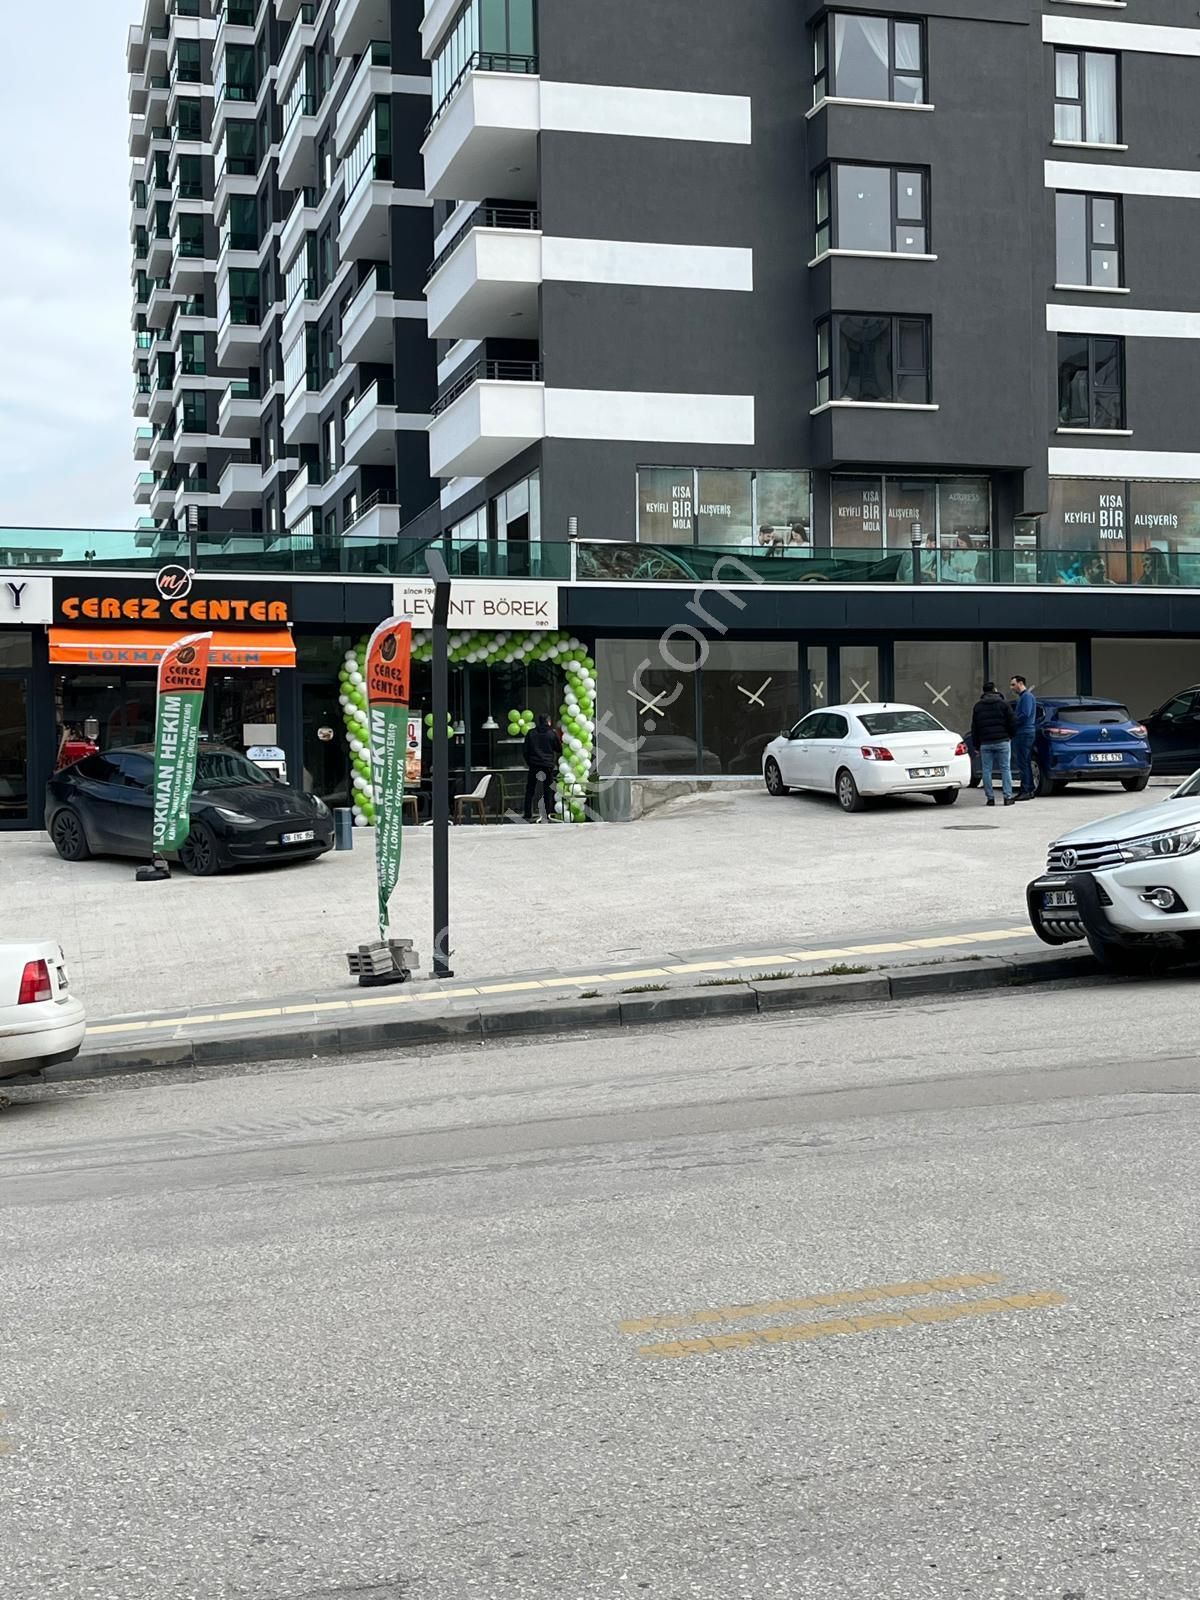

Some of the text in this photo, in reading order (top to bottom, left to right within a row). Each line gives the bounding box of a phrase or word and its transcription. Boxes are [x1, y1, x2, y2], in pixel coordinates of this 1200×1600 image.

[672, 485, 691, 498] KISA
[862, 490, 880, 502] KISA
[646, 499, 731, 517] KEYİFLİ BİR ALIŞVERİŞ
[1099, 494, 1123, 508] KISA
[838, 502, 920, 520] KEYİFLİ BİR ALIŞVERİŞ
[1064, 507, 1178, 528] KEYİFLİ BİR ALIŞVERİŞ
[672, 519, 691, 529] MOLA
[862, 521, 880, 531] MOLA
[1100, 528, 1124, 540] MOLA
[7, 582, 28, 608] Y
[61, 597, 288, 621] ÇEREZ CENTER
[403, 597, 548, 616] LEVNT BÖREK
[165, 675, 202, 686] CENTER
[371, 678, 405, 697] CENTER
[152, 696, 182, 846] LOKMAN HEKİM
[394, 759, 404, 807] ÇİKOLATA
[385, 787, 394, 821] MEYVE
[390, 814, 399, 850] LOKUM
